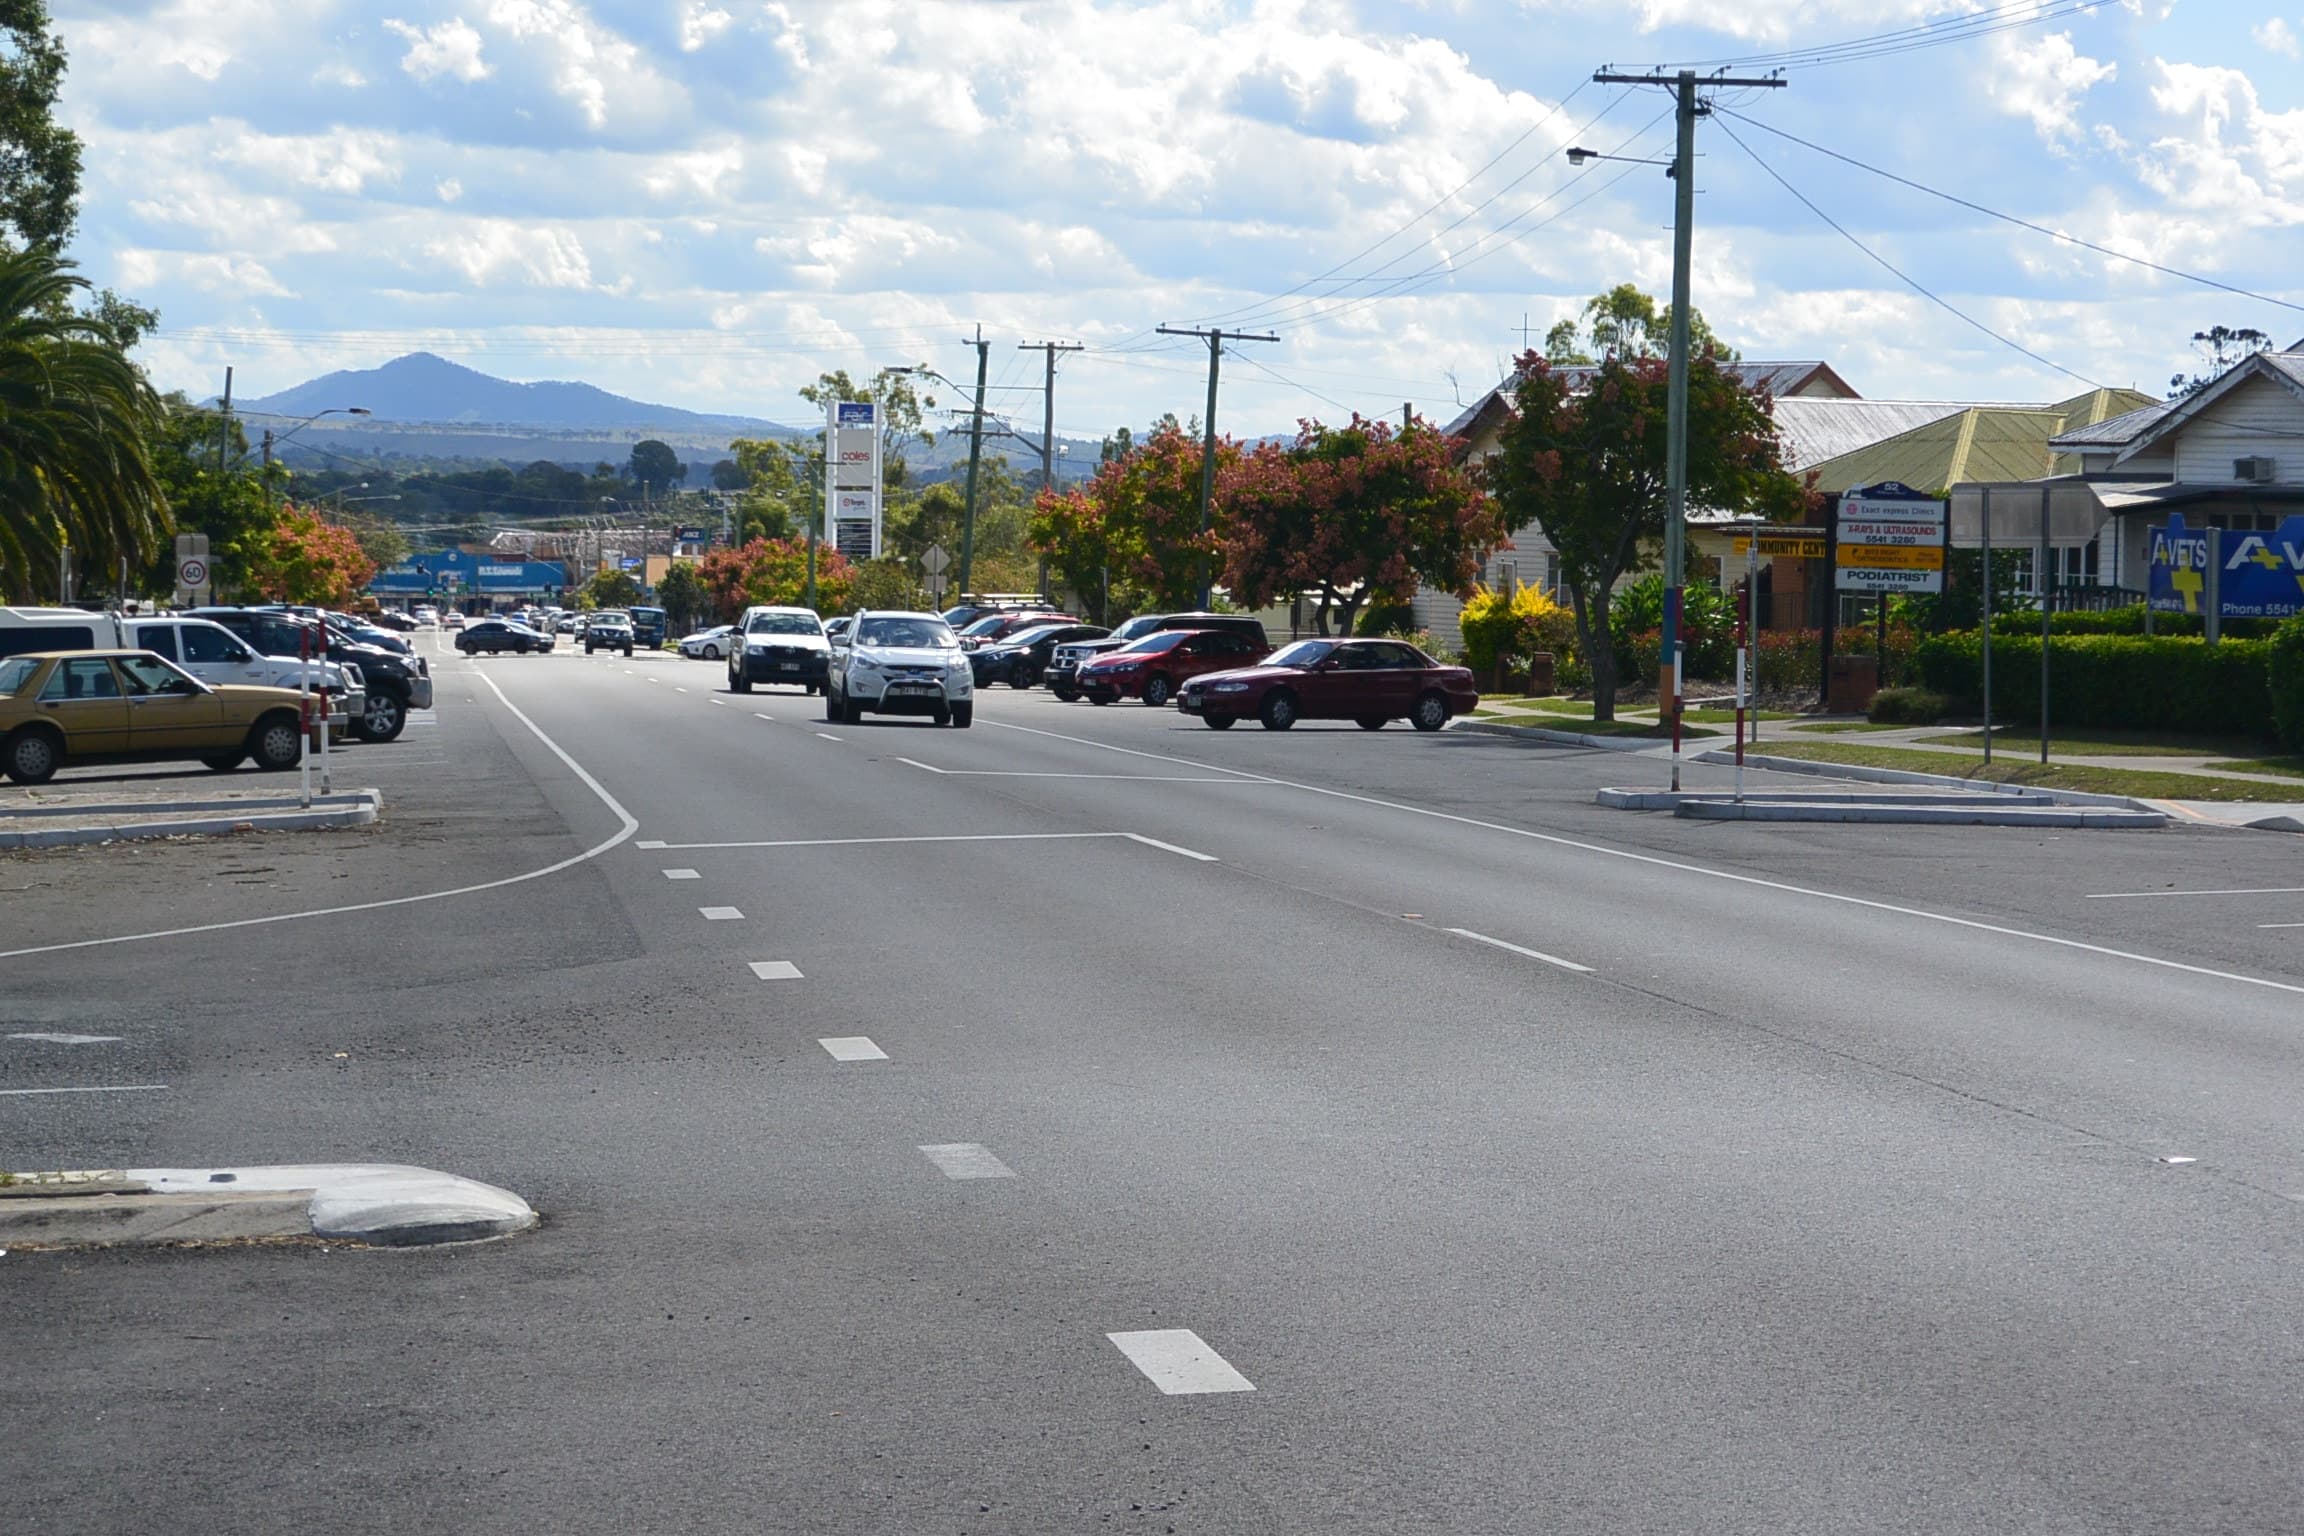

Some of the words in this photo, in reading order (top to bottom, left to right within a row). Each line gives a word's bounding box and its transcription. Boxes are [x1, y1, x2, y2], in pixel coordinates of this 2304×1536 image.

[841, 451, 870, 461] coles
[1884, 483, 1898, 491] 52
[1861, 505, 1880, 514] Exact
[1882, 508, 1909, 516] express
[1847, 525, 1874, 534] X-RAYS
[1883, 526, 1937, 535] ULTRASOUNDS
[1890, 536, 1916, 544] 3280
[186, 567, 201, 578] 60
[1847, 571, 1930, 582] PODIATRIST
[2222, 603, 2262, 614] Phone
[2266, 603, 2295, 616] 5541
